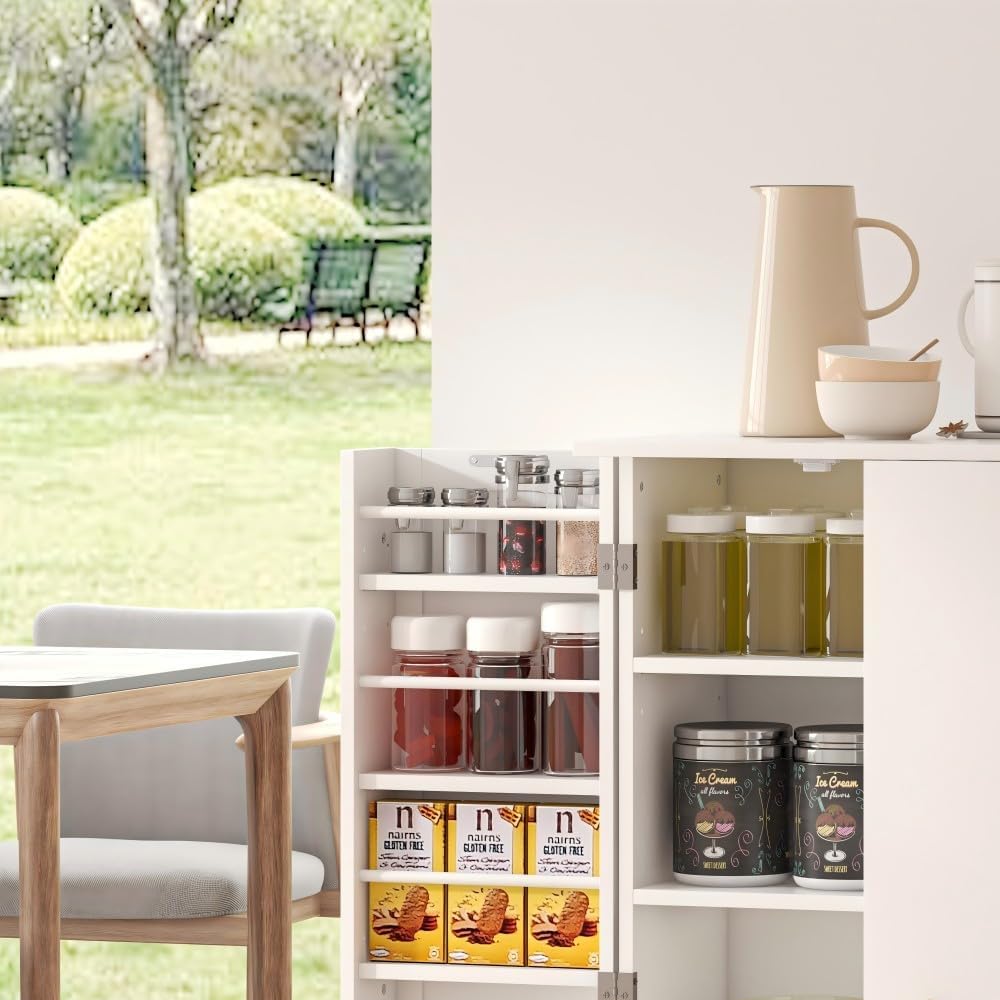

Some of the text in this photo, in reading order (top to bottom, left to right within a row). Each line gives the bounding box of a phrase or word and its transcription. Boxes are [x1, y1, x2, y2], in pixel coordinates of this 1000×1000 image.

[694, 772, 737, 785] Ice Cream
[815, 775, 859, 789] Ice Cream
[708, 787, 729, 796] flavors
[829, 790, 851, 799] flavors
